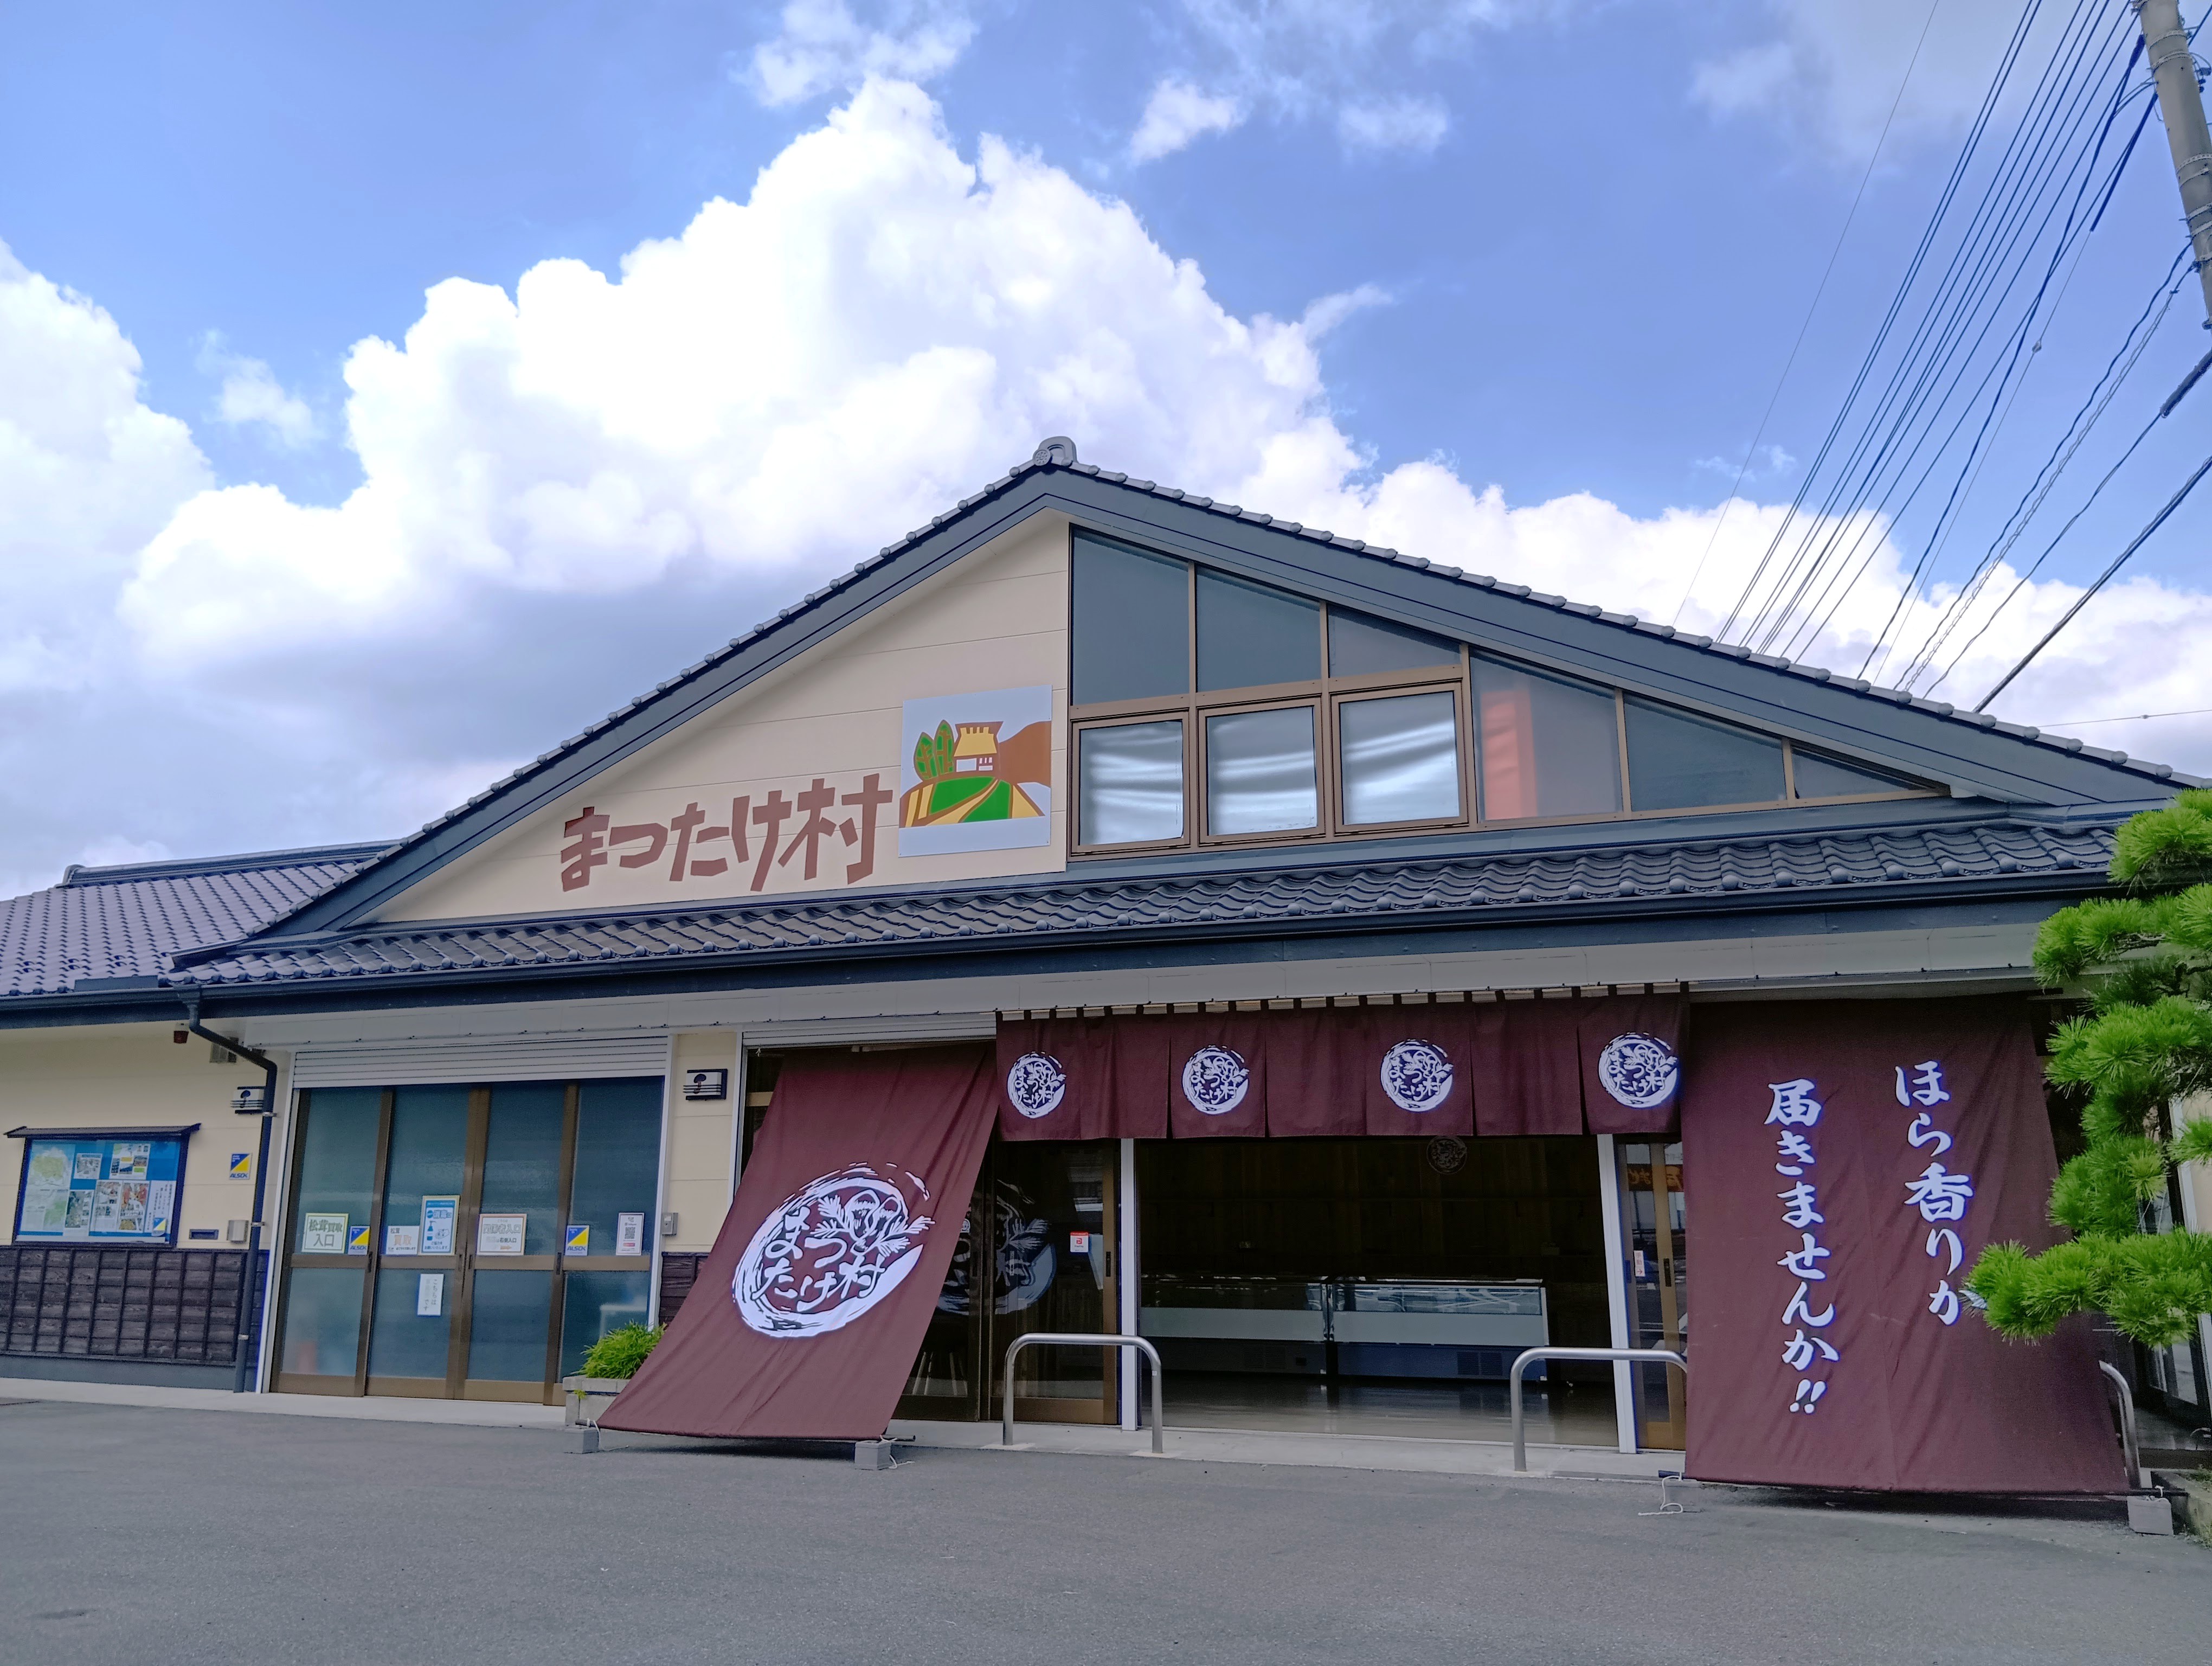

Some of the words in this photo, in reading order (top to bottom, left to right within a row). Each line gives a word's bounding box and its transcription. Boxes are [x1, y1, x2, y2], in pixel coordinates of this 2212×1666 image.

[561, 773, 892, 892] まつたけ村
[308, 1219, 343, 1233] 松茸買取
[313, 1234, 335, 1247] 入口
